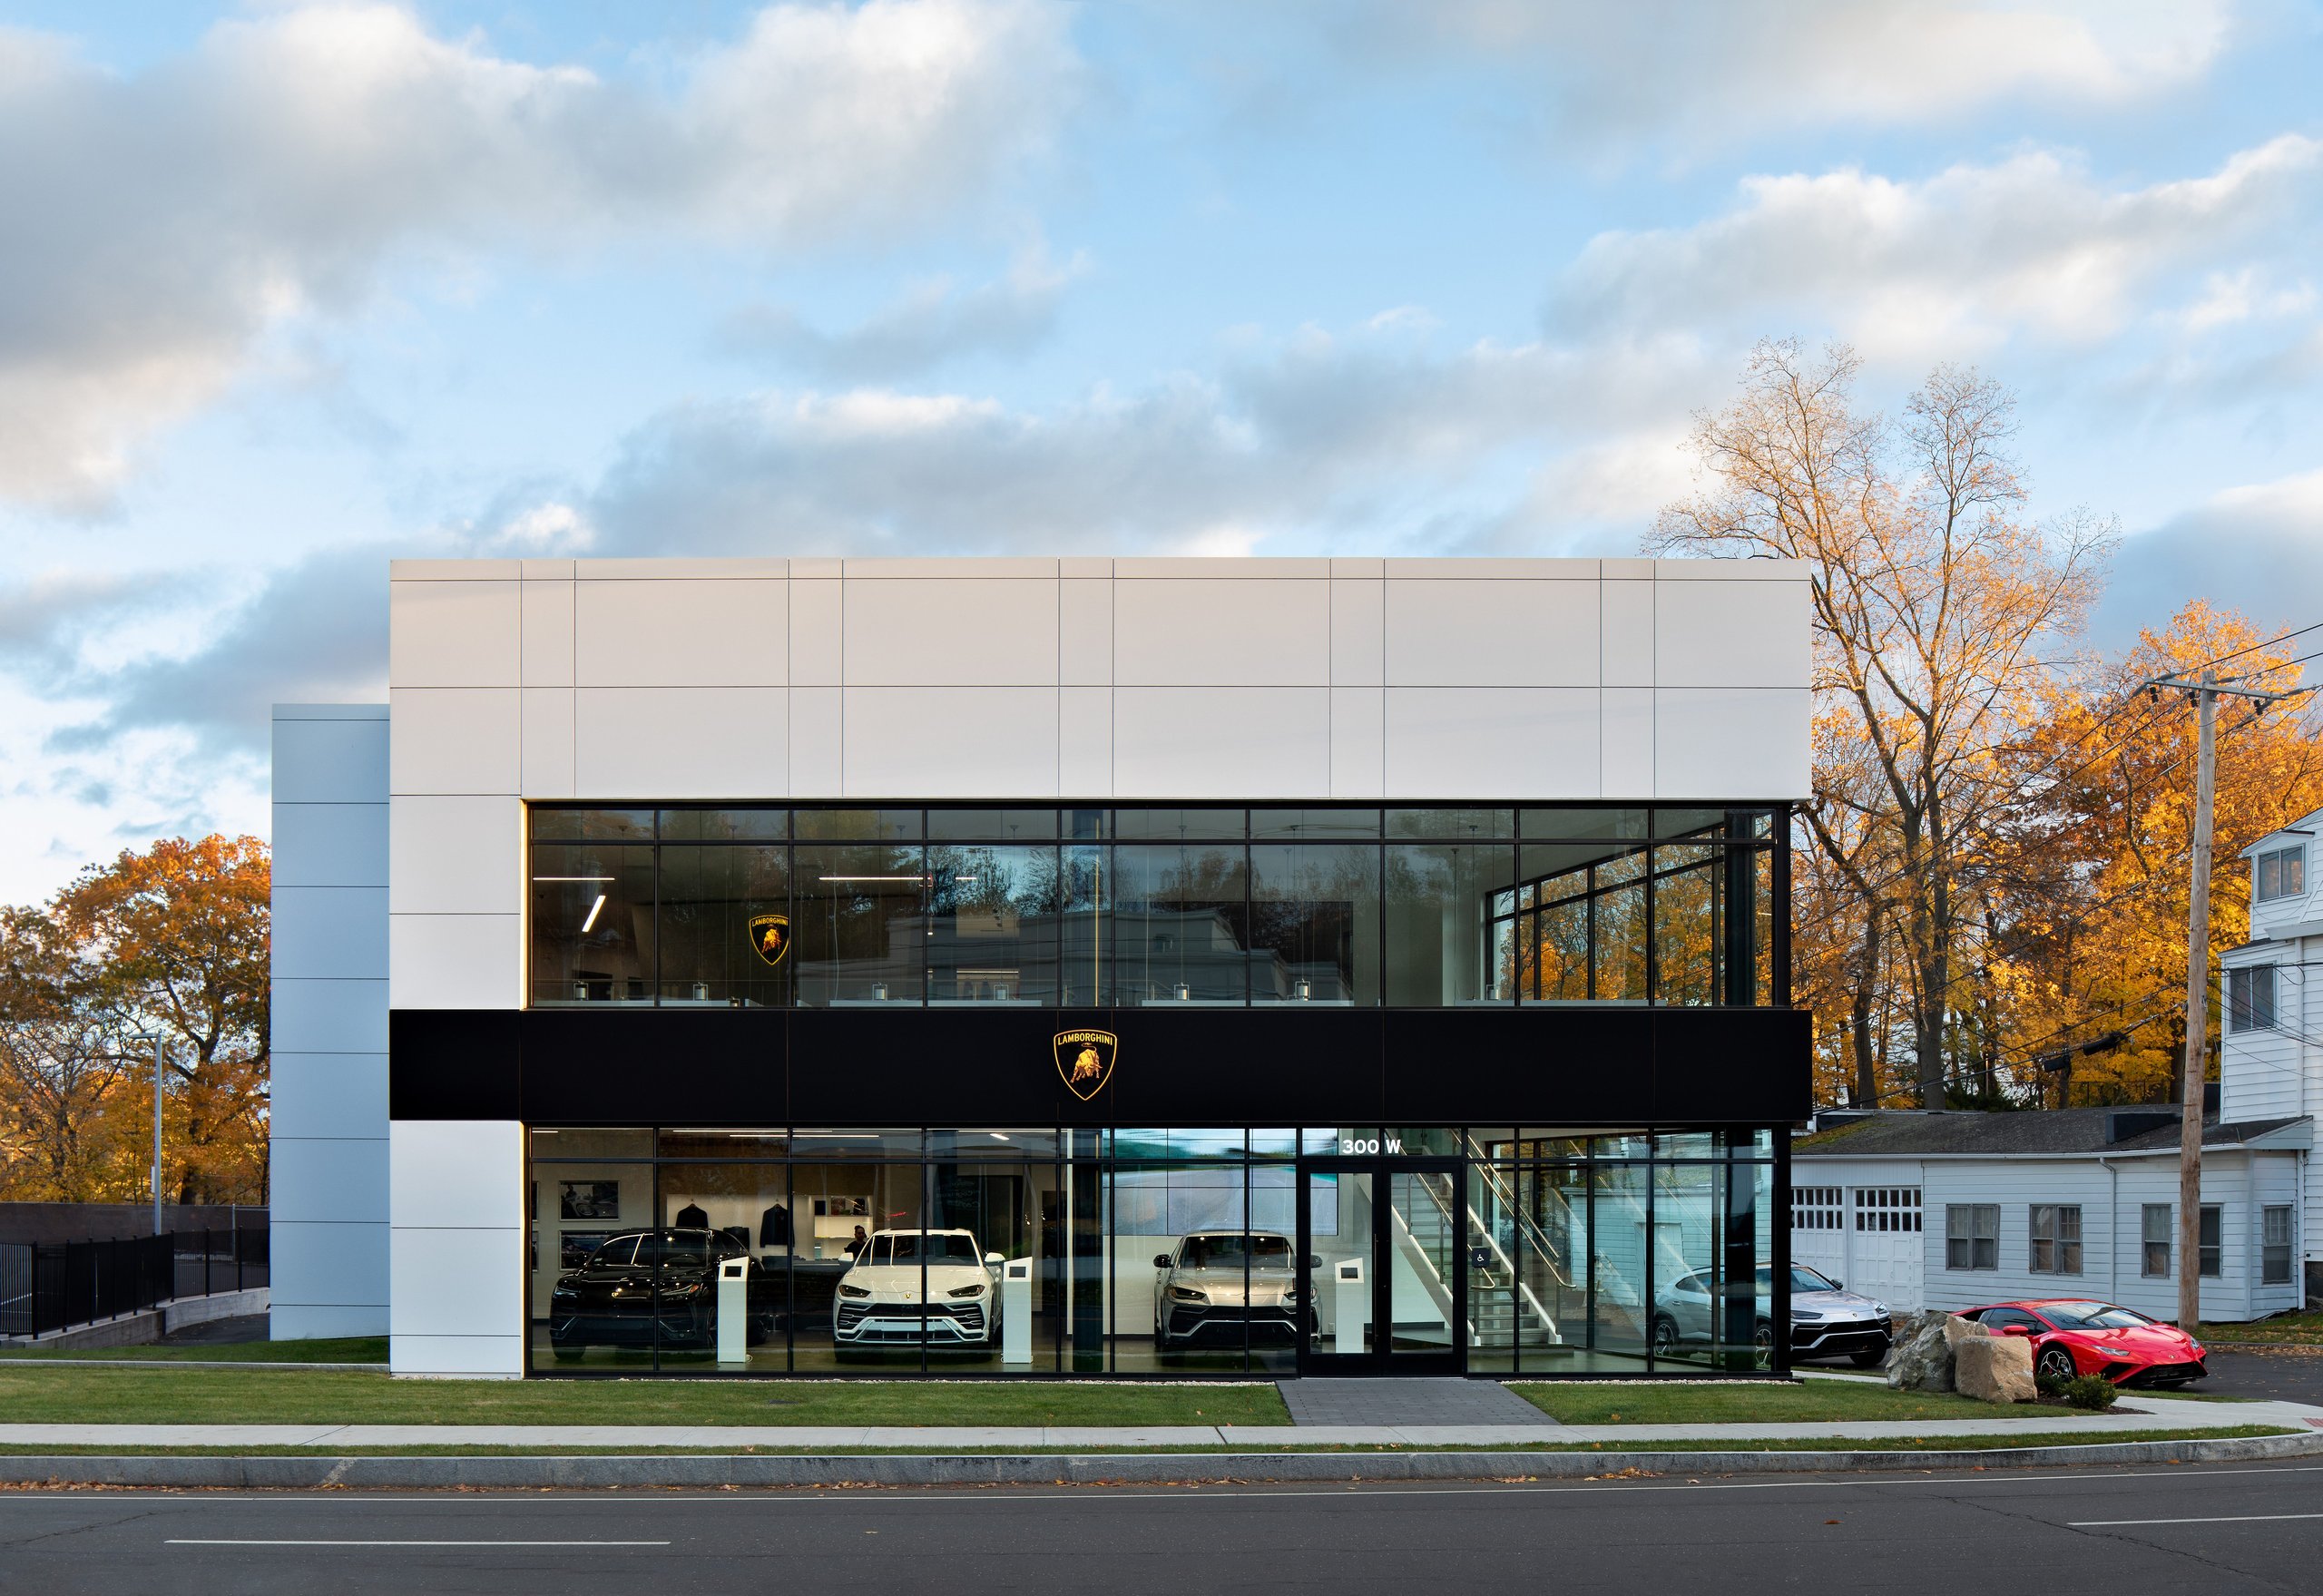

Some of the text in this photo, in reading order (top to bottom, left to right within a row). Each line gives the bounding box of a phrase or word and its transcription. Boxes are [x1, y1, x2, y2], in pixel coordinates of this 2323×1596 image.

[751, 917, 789, 927] LAMBORGHINI
[1057, 1033, 1112, 1045] LAMBORGHINI
[1342, 1139, 1401, 1154] 300 W
